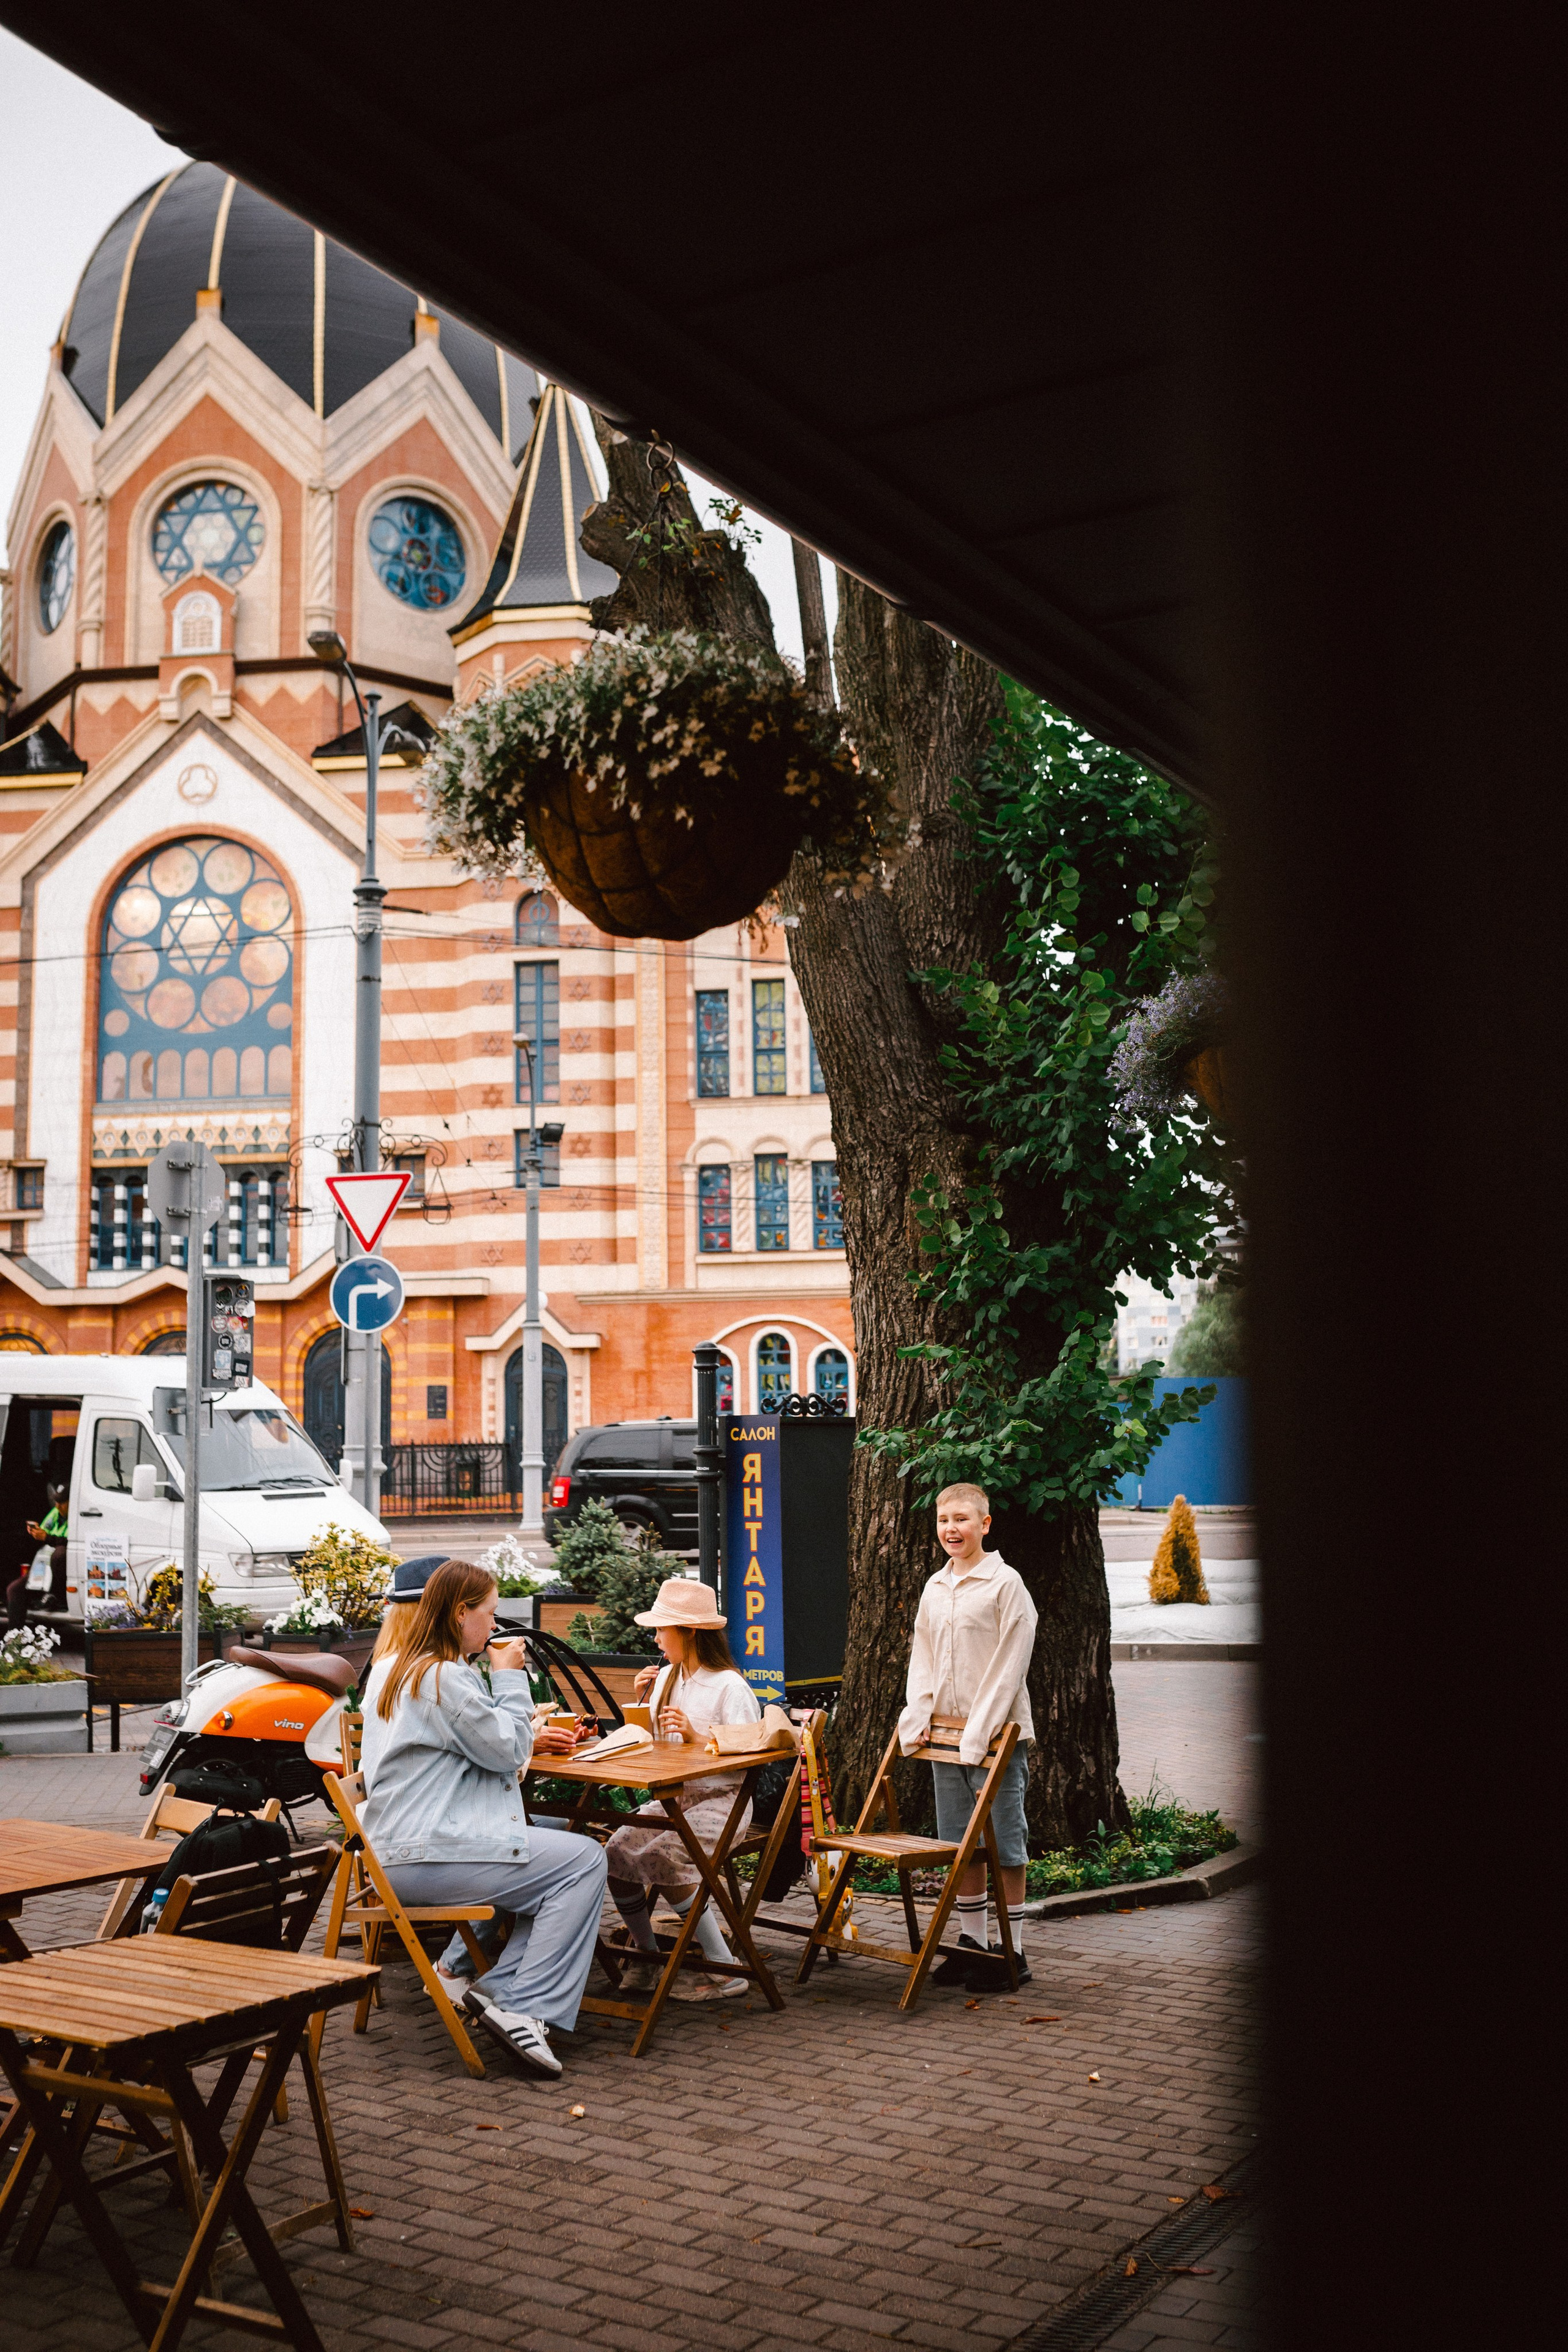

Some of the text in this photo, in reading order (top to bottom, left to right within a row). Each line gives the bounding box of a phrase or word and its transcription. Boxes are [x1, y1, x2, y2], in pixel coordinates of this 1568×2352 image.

[730, 1427, 775, 1441] САЛОН
[742, 1452, 766, 1656] ЯНТАРЯ
[743, 1668, 784, 1682] МЕТРОВ
[274, 1718, 305, 1730] vino
